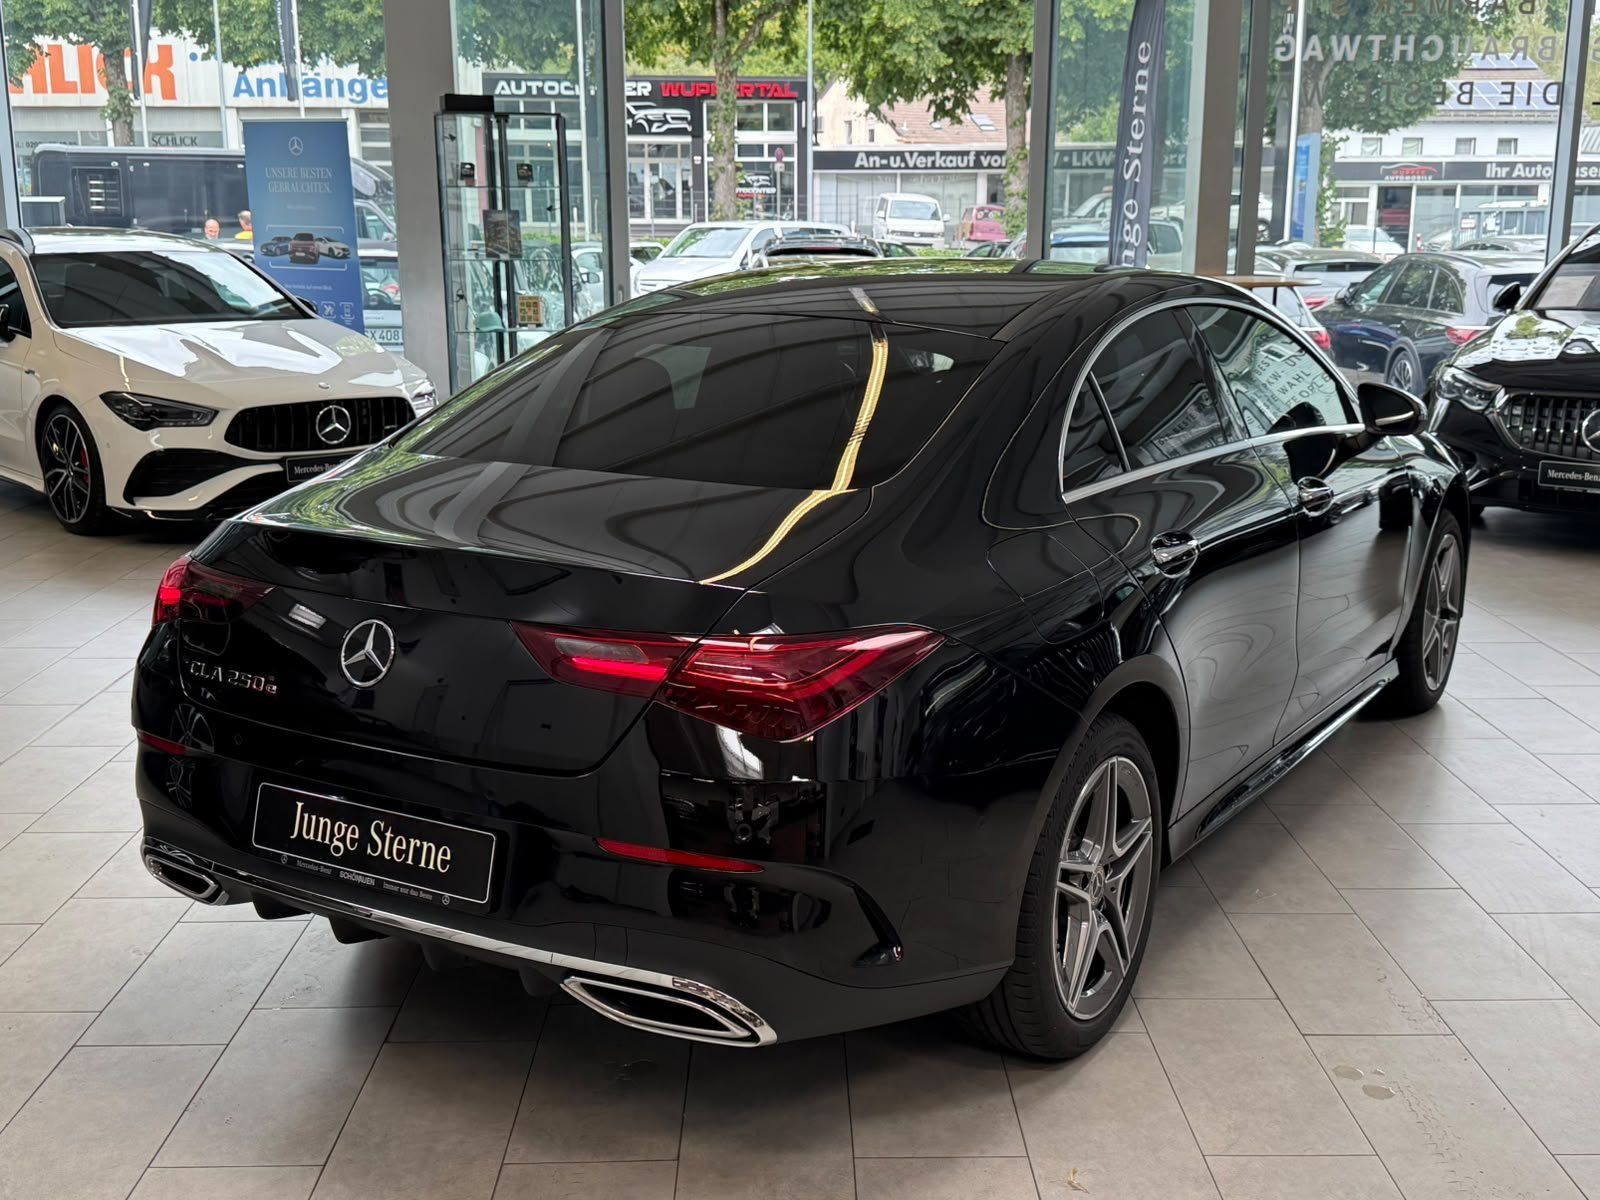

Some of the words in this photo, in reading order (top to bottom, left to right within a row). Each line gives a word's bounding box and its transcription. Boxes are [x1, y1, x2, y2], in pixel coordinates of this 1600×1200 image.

[1123, 40, 1152, 182] Sterne
[151, 135, 198, 147] SCHLICK
[265, 167, 298, 179] UNSERE
[300, 167, 333, 179] BESTEN
[1485, 162, 1509, 178] Ihr
[1512, 162, 1552, 178] Auto
[1120, 199, 1141, 267] nge
[379, 330, 400, 342] 408
[189, 660, 223, 683] CLA
[289, 801, 360, 857] Junge
[366, 819, 452, 874] Sterne
[296, 859, 332, 875] Mercedes-Benz
